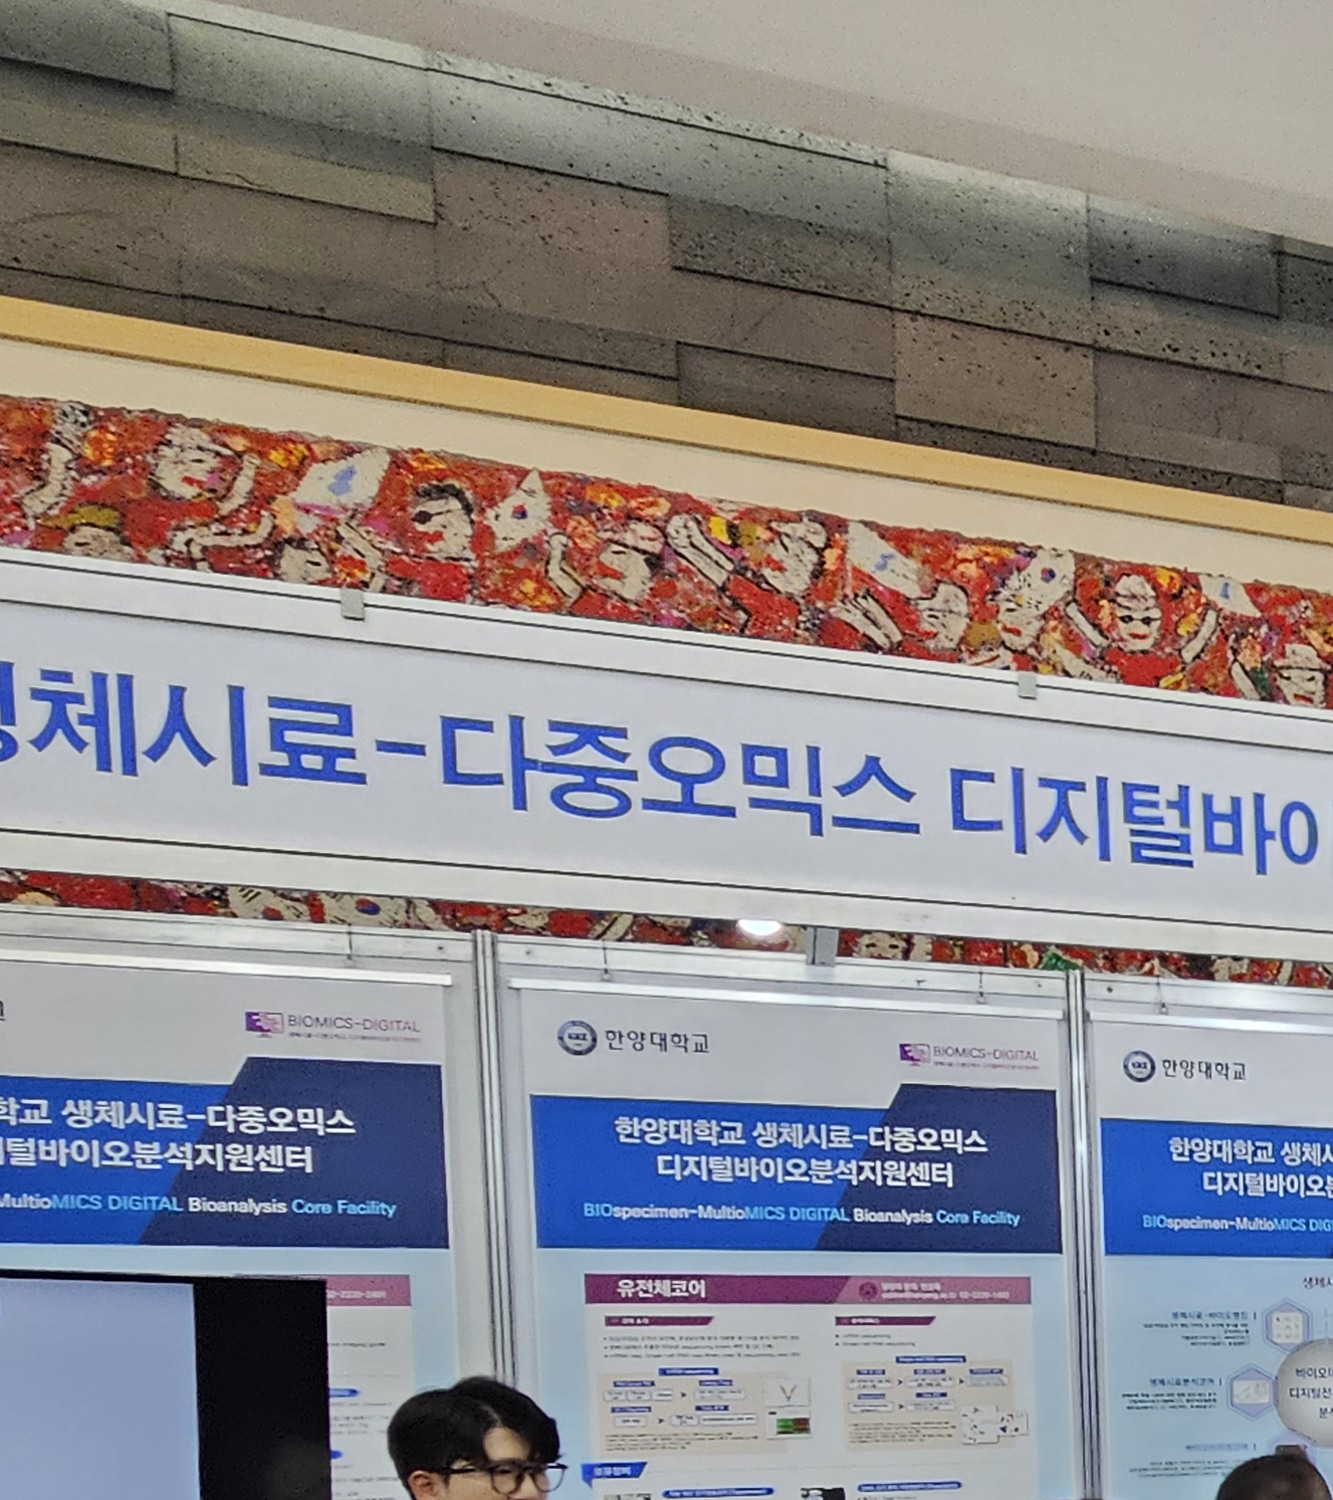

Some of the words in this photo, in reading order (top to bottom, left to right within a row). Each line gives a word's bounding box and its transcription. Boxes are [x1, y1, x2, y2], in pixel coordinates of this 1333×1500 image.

[288, 1014, 421, 1033] BIOMICS-DIGITAL
[604, 1029, 710, 1055] 한양대학교
[933, 1046, 1039, 1063] BIOMICS-DIGITAL
[1161, 1058, 1247, 1081] 한양대학교
[61, 1100, 356, 1135] 생체시료-다중오믹스
[614, 1116, 747, 1146] 한양대학교
[752, 1121, 989, 1155] 생체시료-다중오믹스
[0, 1137, 313, 1173] 털바이오분석지원센터
[1168, 1136, 1276, 1164] 한양대학교
[656, 1154, 954, 1188] 디지털바이오분석지원센터
[108, 1195, 183, 1212] DIGITAL
[188, 1197, 288, 1216] Bioanalysis
[292, 1199, 331, 1214] Core
[337, 1200, 397, 1218] Facility
[583, 1203, 786, 1221] BIOspecimen-MultioMICS
[789, 1206, 849, 1222] DIGITAL
[853, 1208, 933, 1225] Bioanalysis
[936, 1209, 970, 1224] Core
[972, 1210, 1021, 1227] Facility
[616, 1279, 707, 1298] 유전체코어
